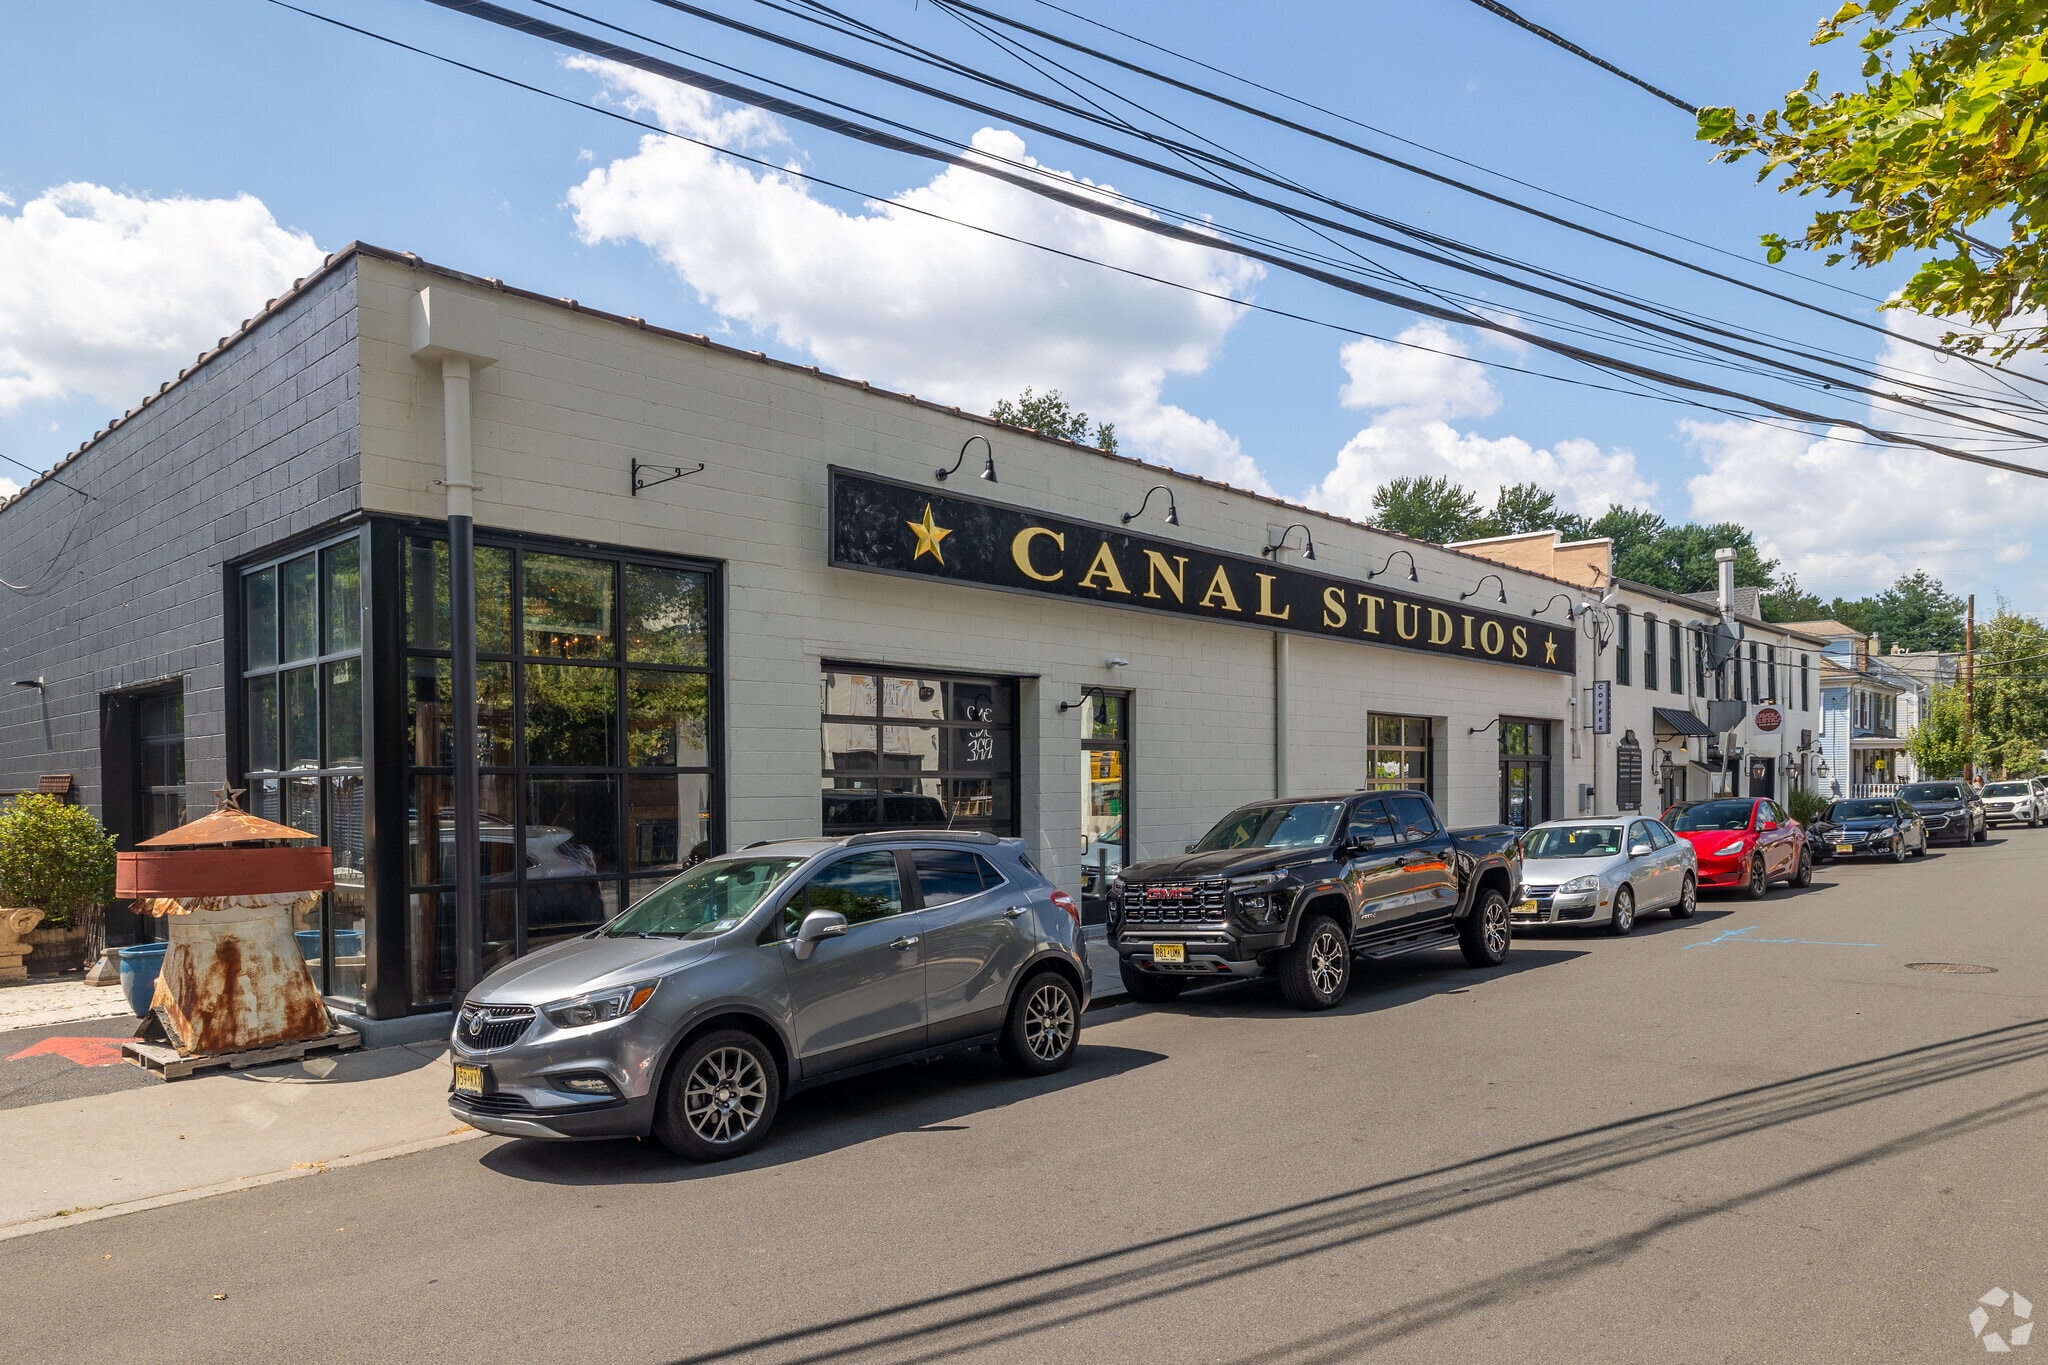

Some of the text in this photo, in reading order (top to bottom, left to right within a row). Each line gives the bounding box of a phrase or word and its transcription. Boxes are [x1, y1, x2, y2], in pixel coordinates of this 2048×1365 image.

[1011, 526, 1528, 659] CANAL STUDIOS
[1146, 887, 1193, 900] GMC
